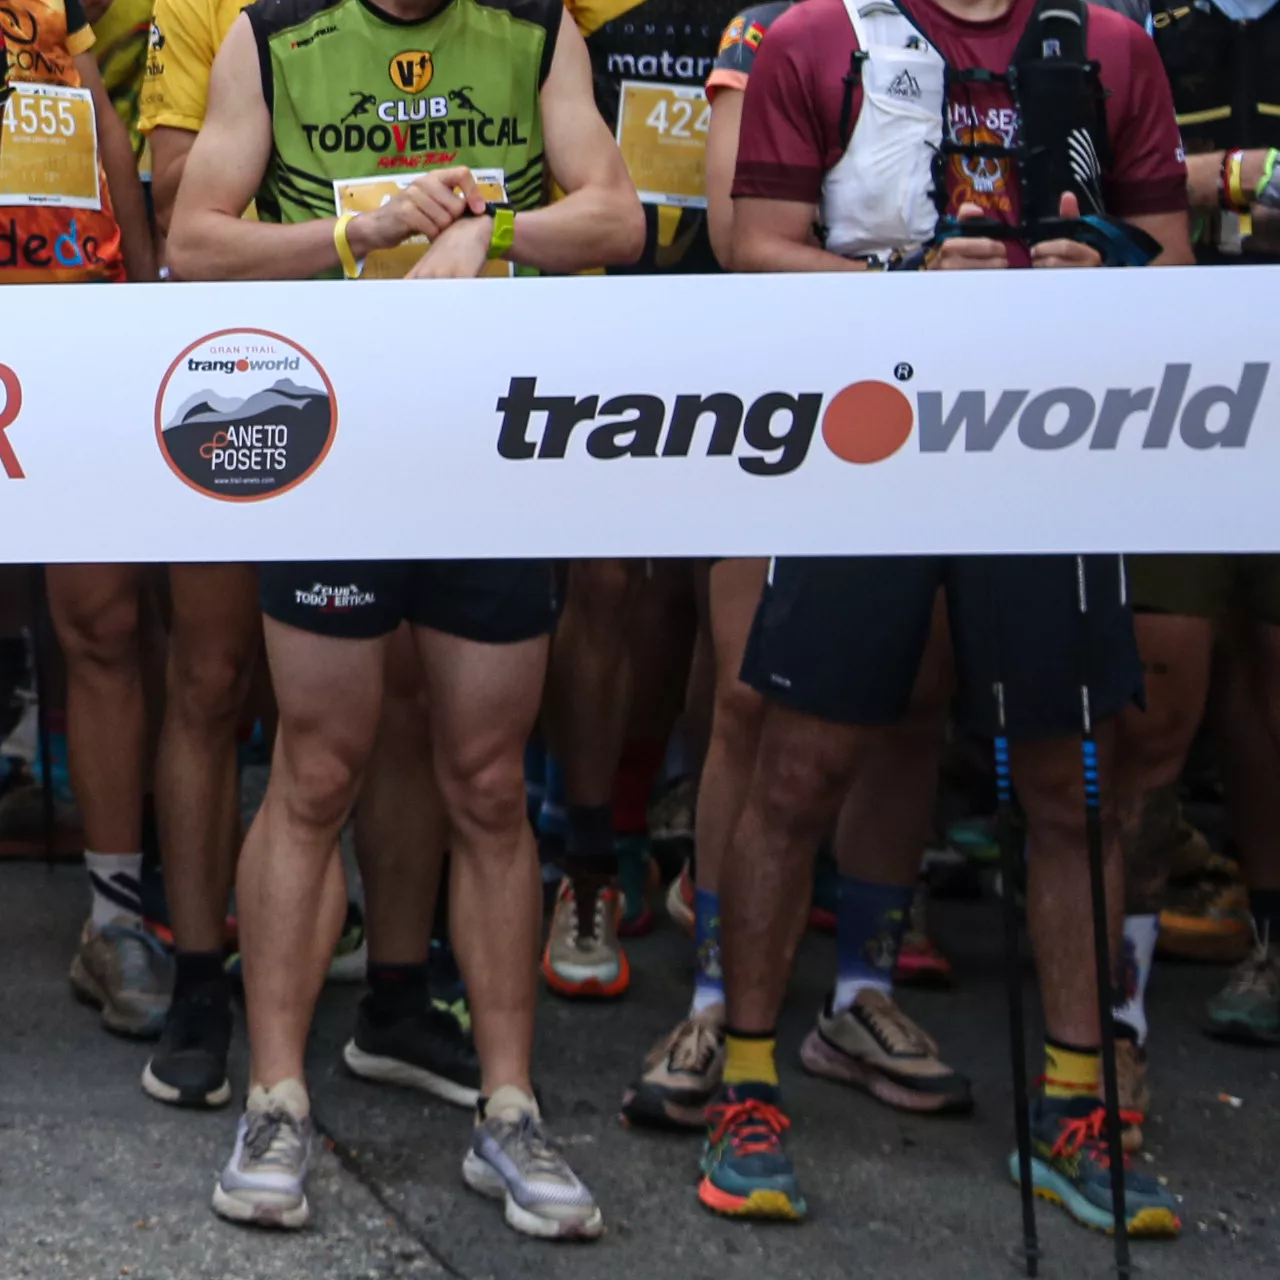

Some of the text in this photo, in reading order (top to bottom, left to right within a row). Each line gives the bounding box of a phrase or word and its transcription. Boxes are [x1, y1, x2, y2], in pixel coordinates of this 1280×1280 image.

[1, 97, 76, 137] 4555
[377, 96, 449, 122] CLUB
[301, 117, 528, 154] TODOVERTICAL
[210, 346, 277, 354] GRAN TRAIL
[187, 356, 300, 375] trangoworld
[495, 361, 1271, 477] trangoworld
[227, 425, 288, 447] ANETO
[212, 448, 287, 471] POSETS
